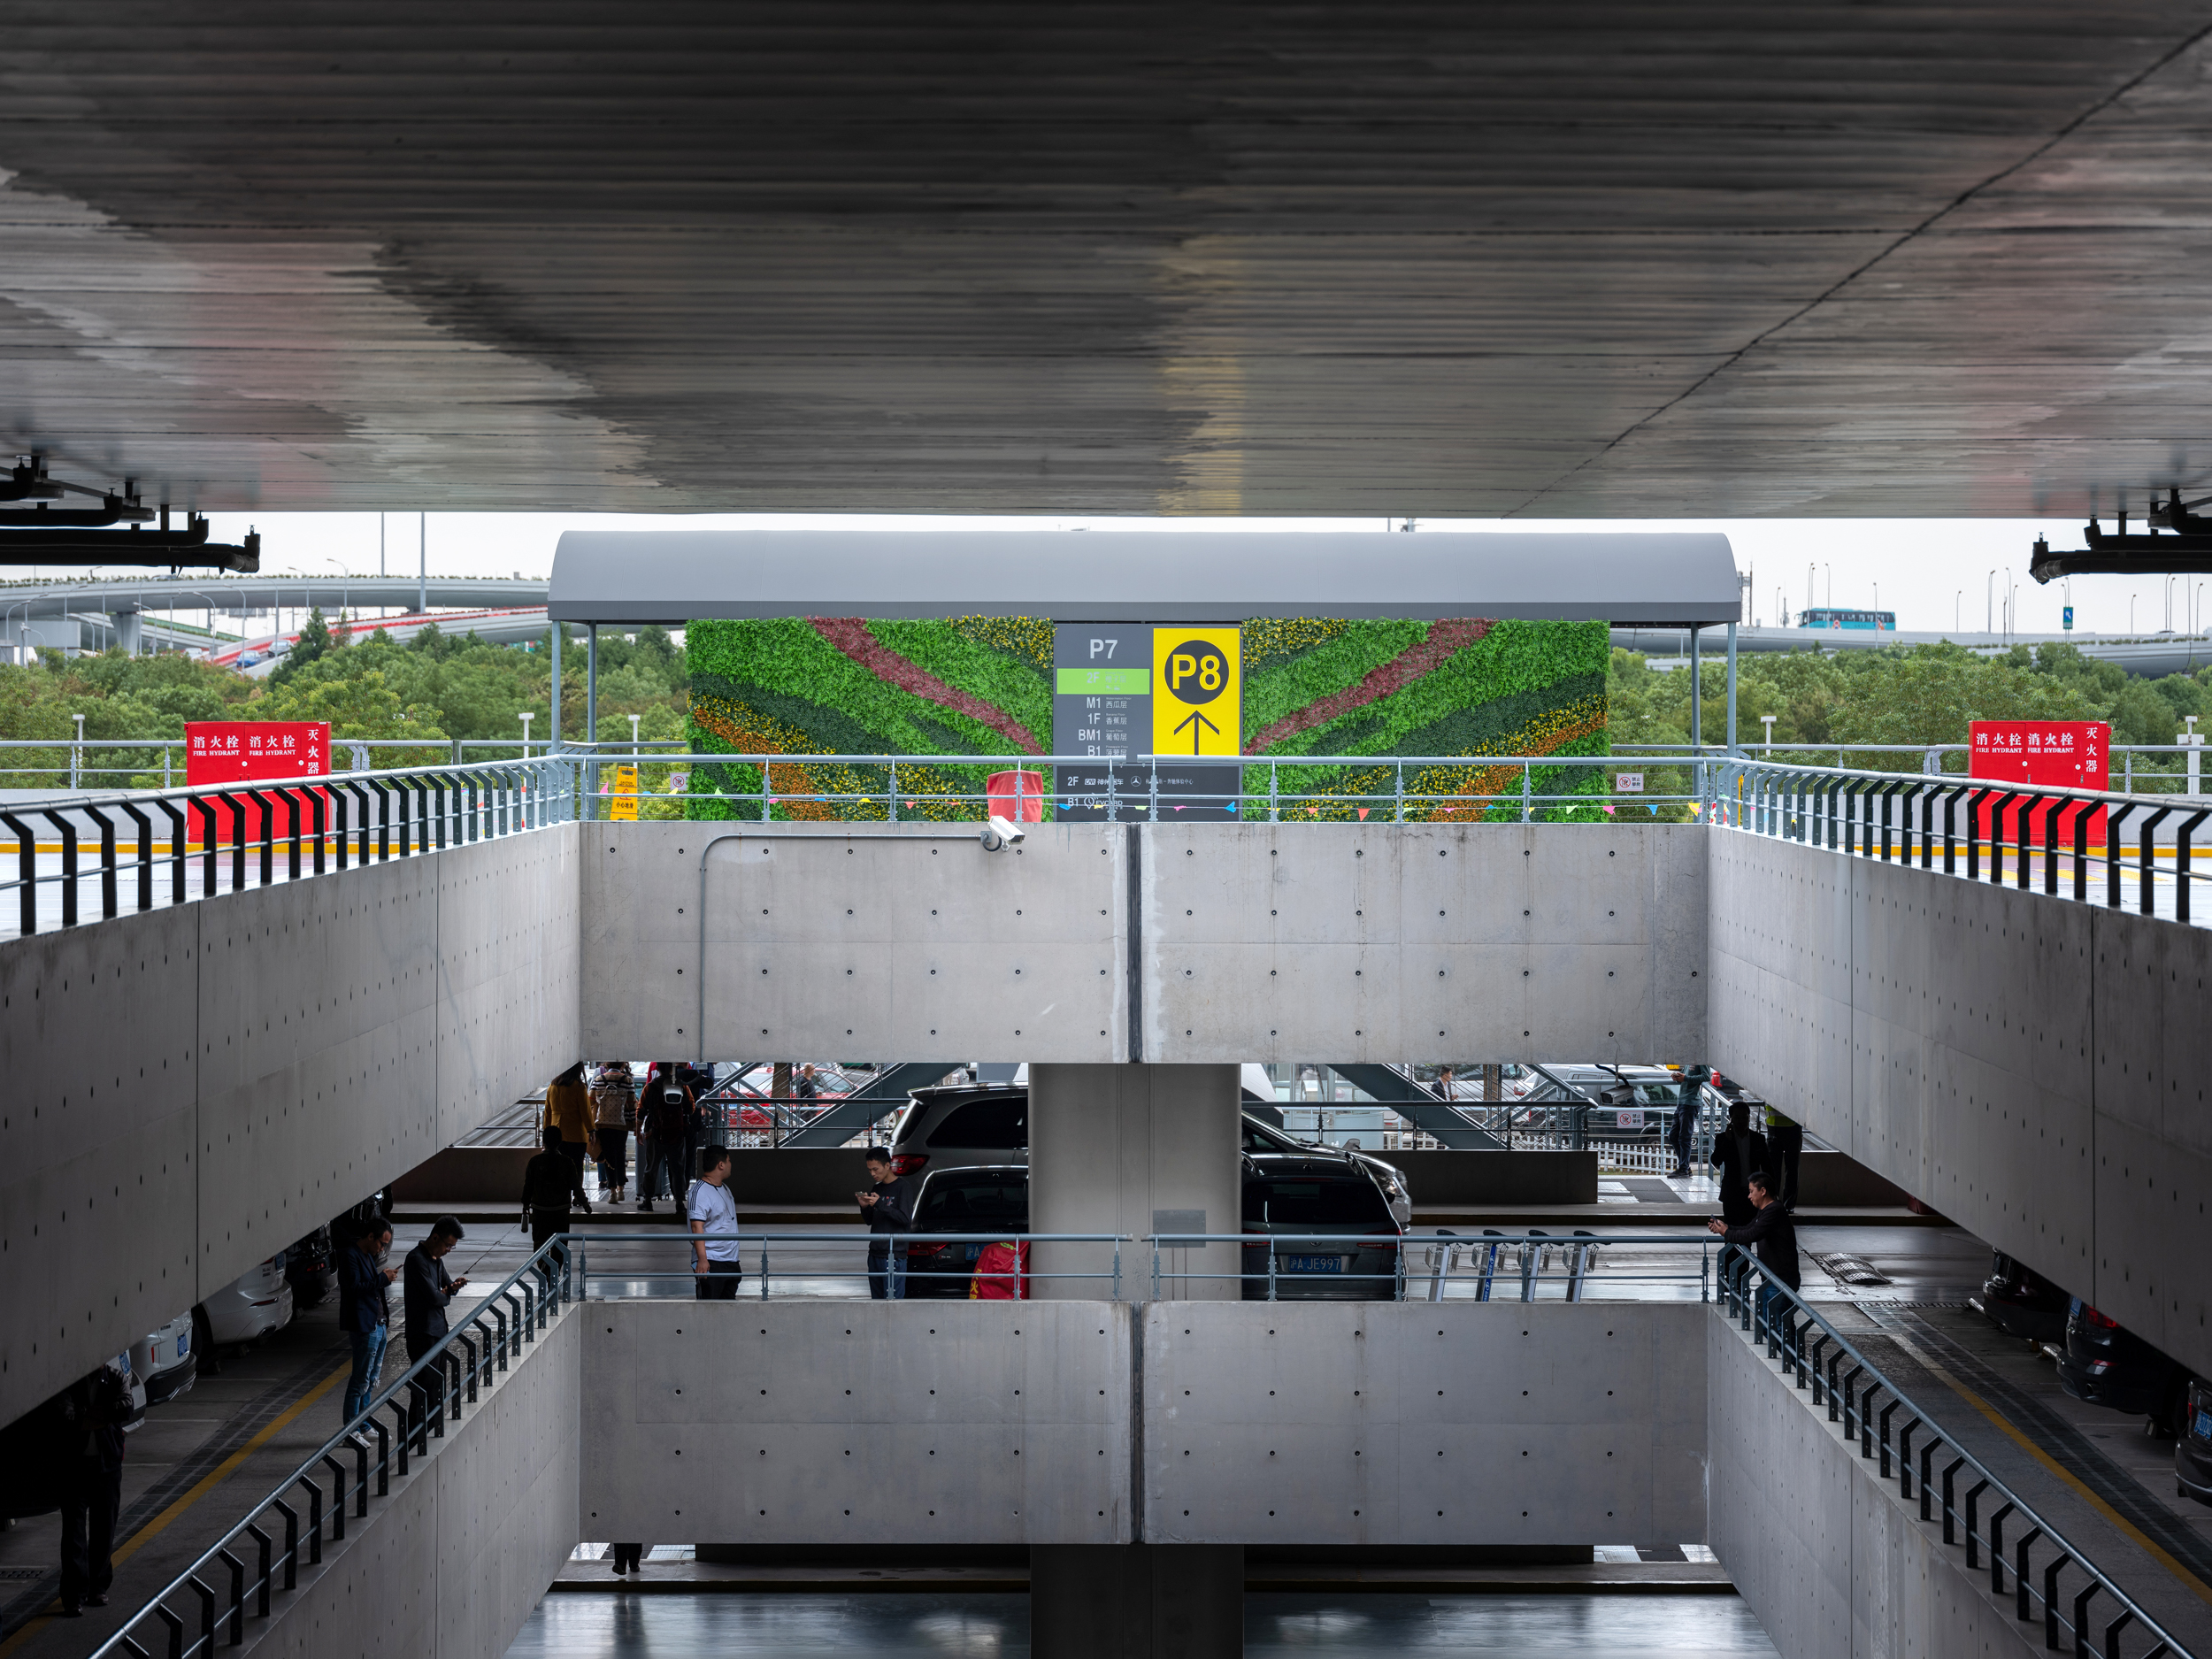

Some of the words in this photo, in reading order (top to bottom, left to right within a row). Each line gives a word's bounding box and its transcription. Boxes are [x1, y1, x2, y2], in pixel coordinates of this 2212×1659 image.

[1090, 639, 1118, 659] P7
[1087, 672, 1100, 683] 2F
[1172, 654, 1221, 691] P8
[1087, 697, 1101, 709] M1
[1088, 713, 1101, 725] 1F
[249, 734, 296, 749] 消火栓
[1079, 729, 1101, 741] BM1
[1976, 733, 2022, 746] 消火栓
[2027, 733, 2074, 746] 消火栓
[193, 735, 240, 749] 消火栓
[307, 728, 319, 775] 灭火器
[1087, 745, 1101, 757] B1
[2085, 726, 2098, 772] 灭火器
[1067, 776, 1079, 787] 2F
[1067, 797, 1079, 807] B1
